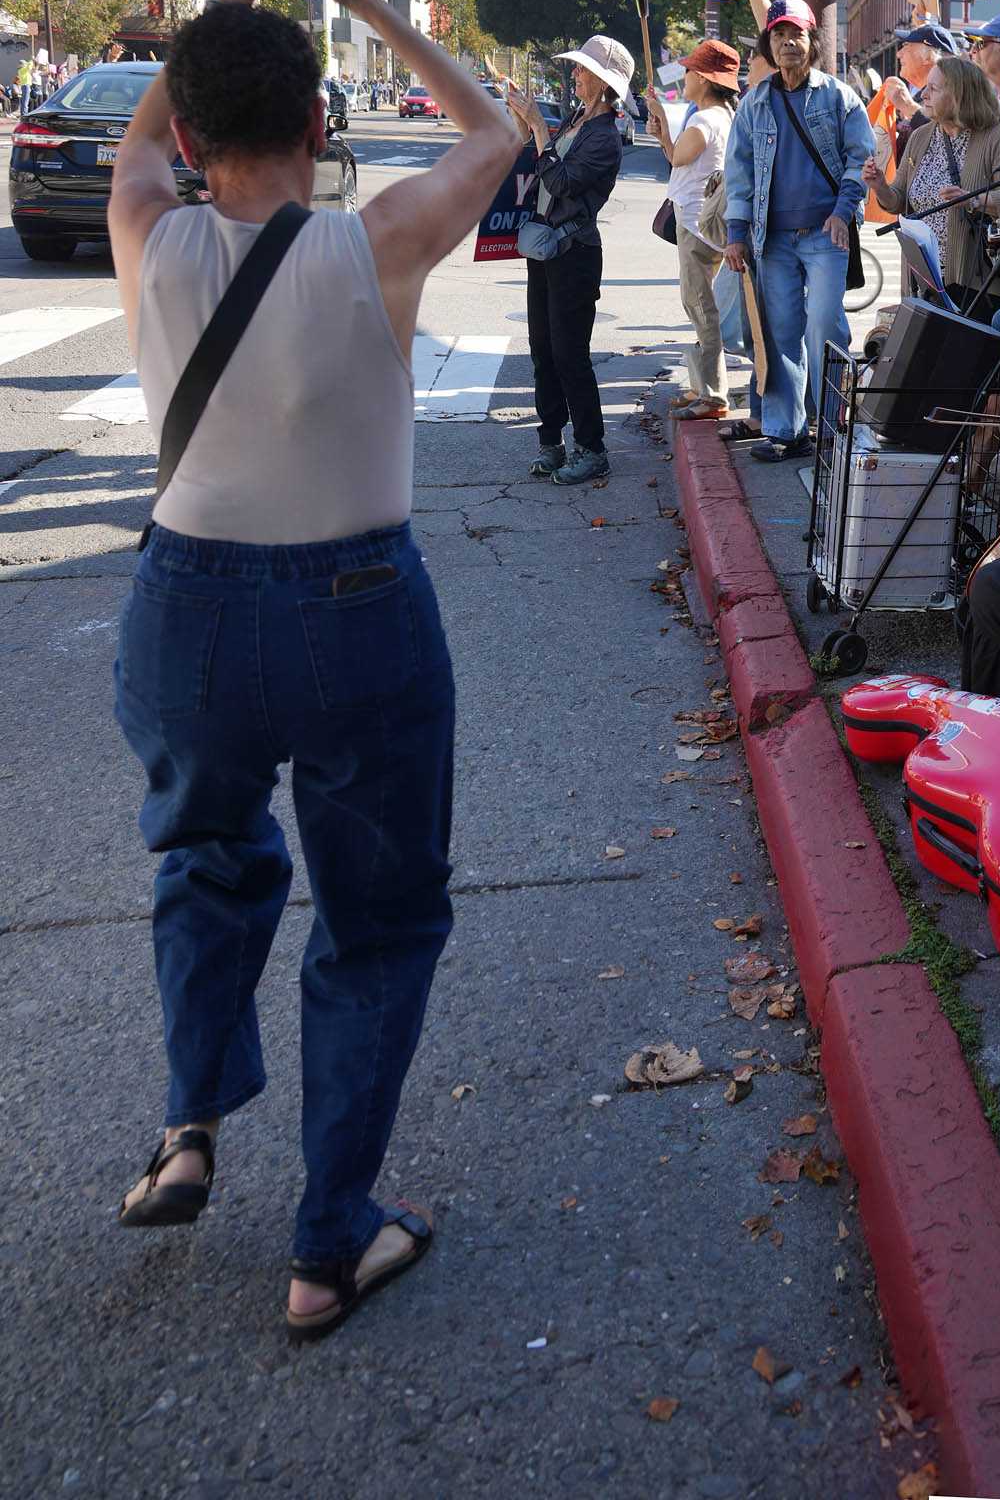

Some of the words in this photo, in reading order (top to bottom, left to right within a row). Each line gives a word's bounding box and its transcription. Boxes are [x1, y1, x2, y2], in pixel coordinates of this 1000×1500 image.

[515, 172, 537, 206] Y
[489, 211, 515, 231] ON
[480, 243, 513, 253] ELECTION
